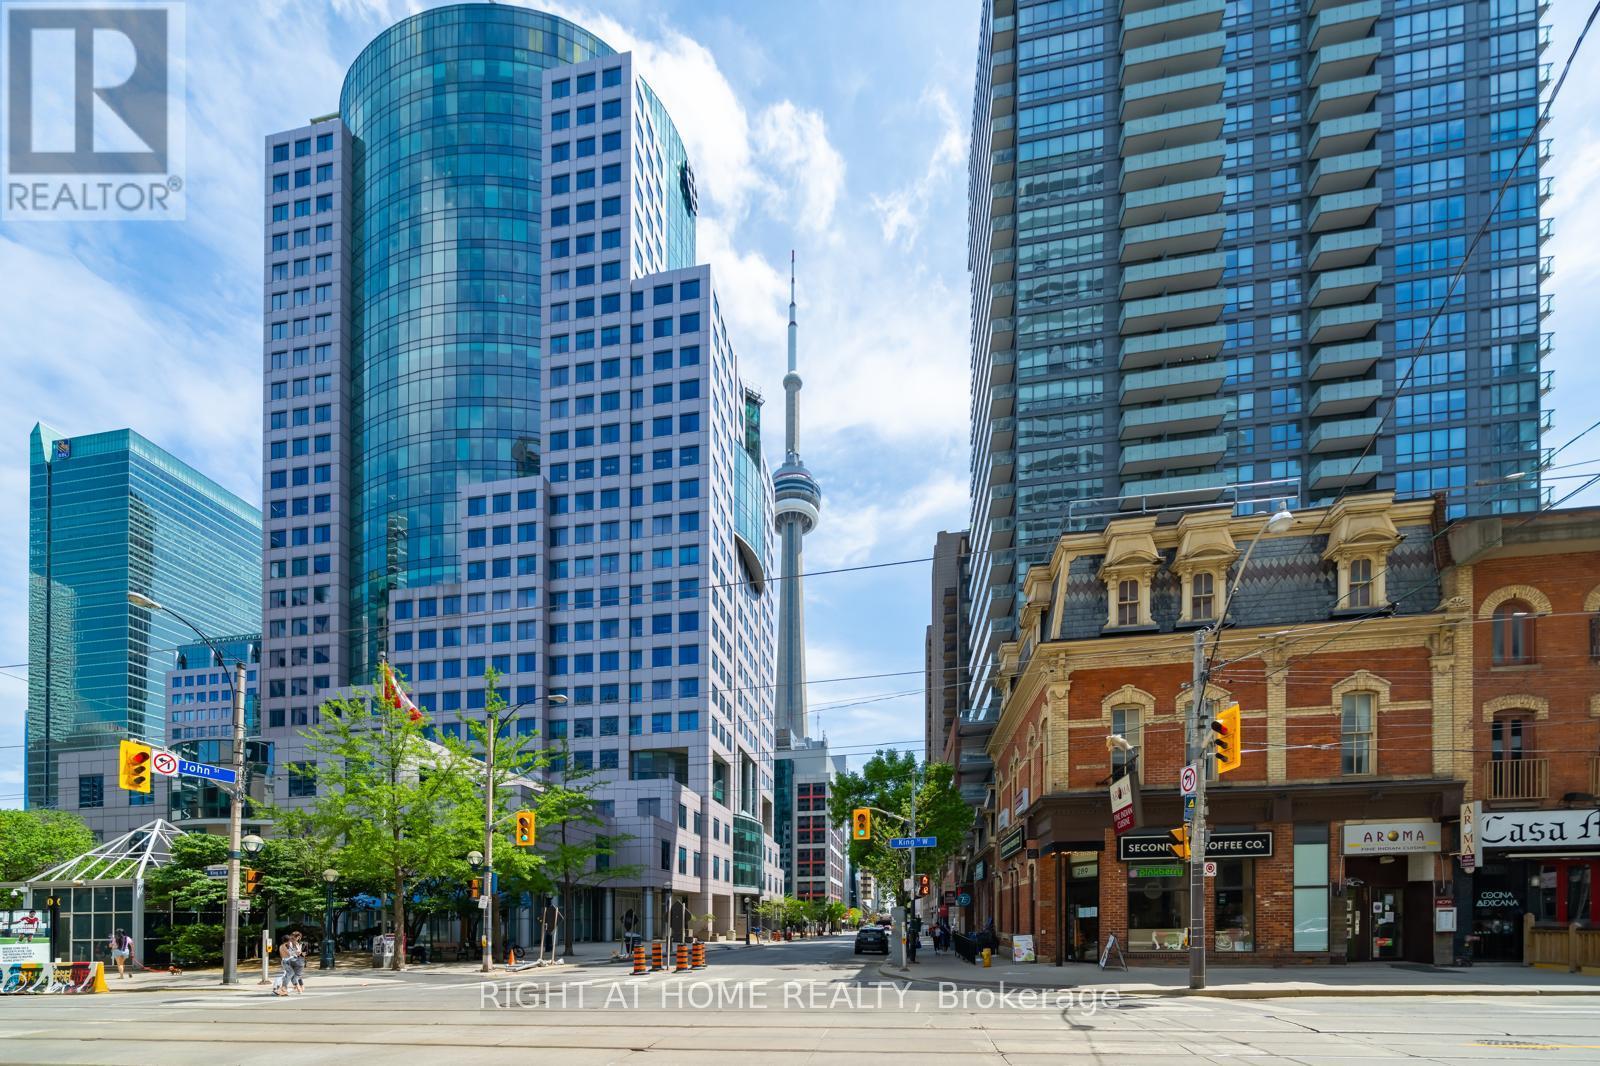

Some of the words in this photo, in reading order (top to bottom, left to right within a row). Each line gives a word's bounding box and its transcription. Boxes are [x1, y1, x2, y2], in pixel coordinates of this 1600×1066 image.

[183, 762, 210, 776] John
[1481, 815, 1568, 843] Casa
[1363, 830, 1425, 843] AROMA
[898, 839, 915, 847] King
[1205, 841, 1242, 851] OFFEE
[1481, 891, 1513, 899] COCINA
